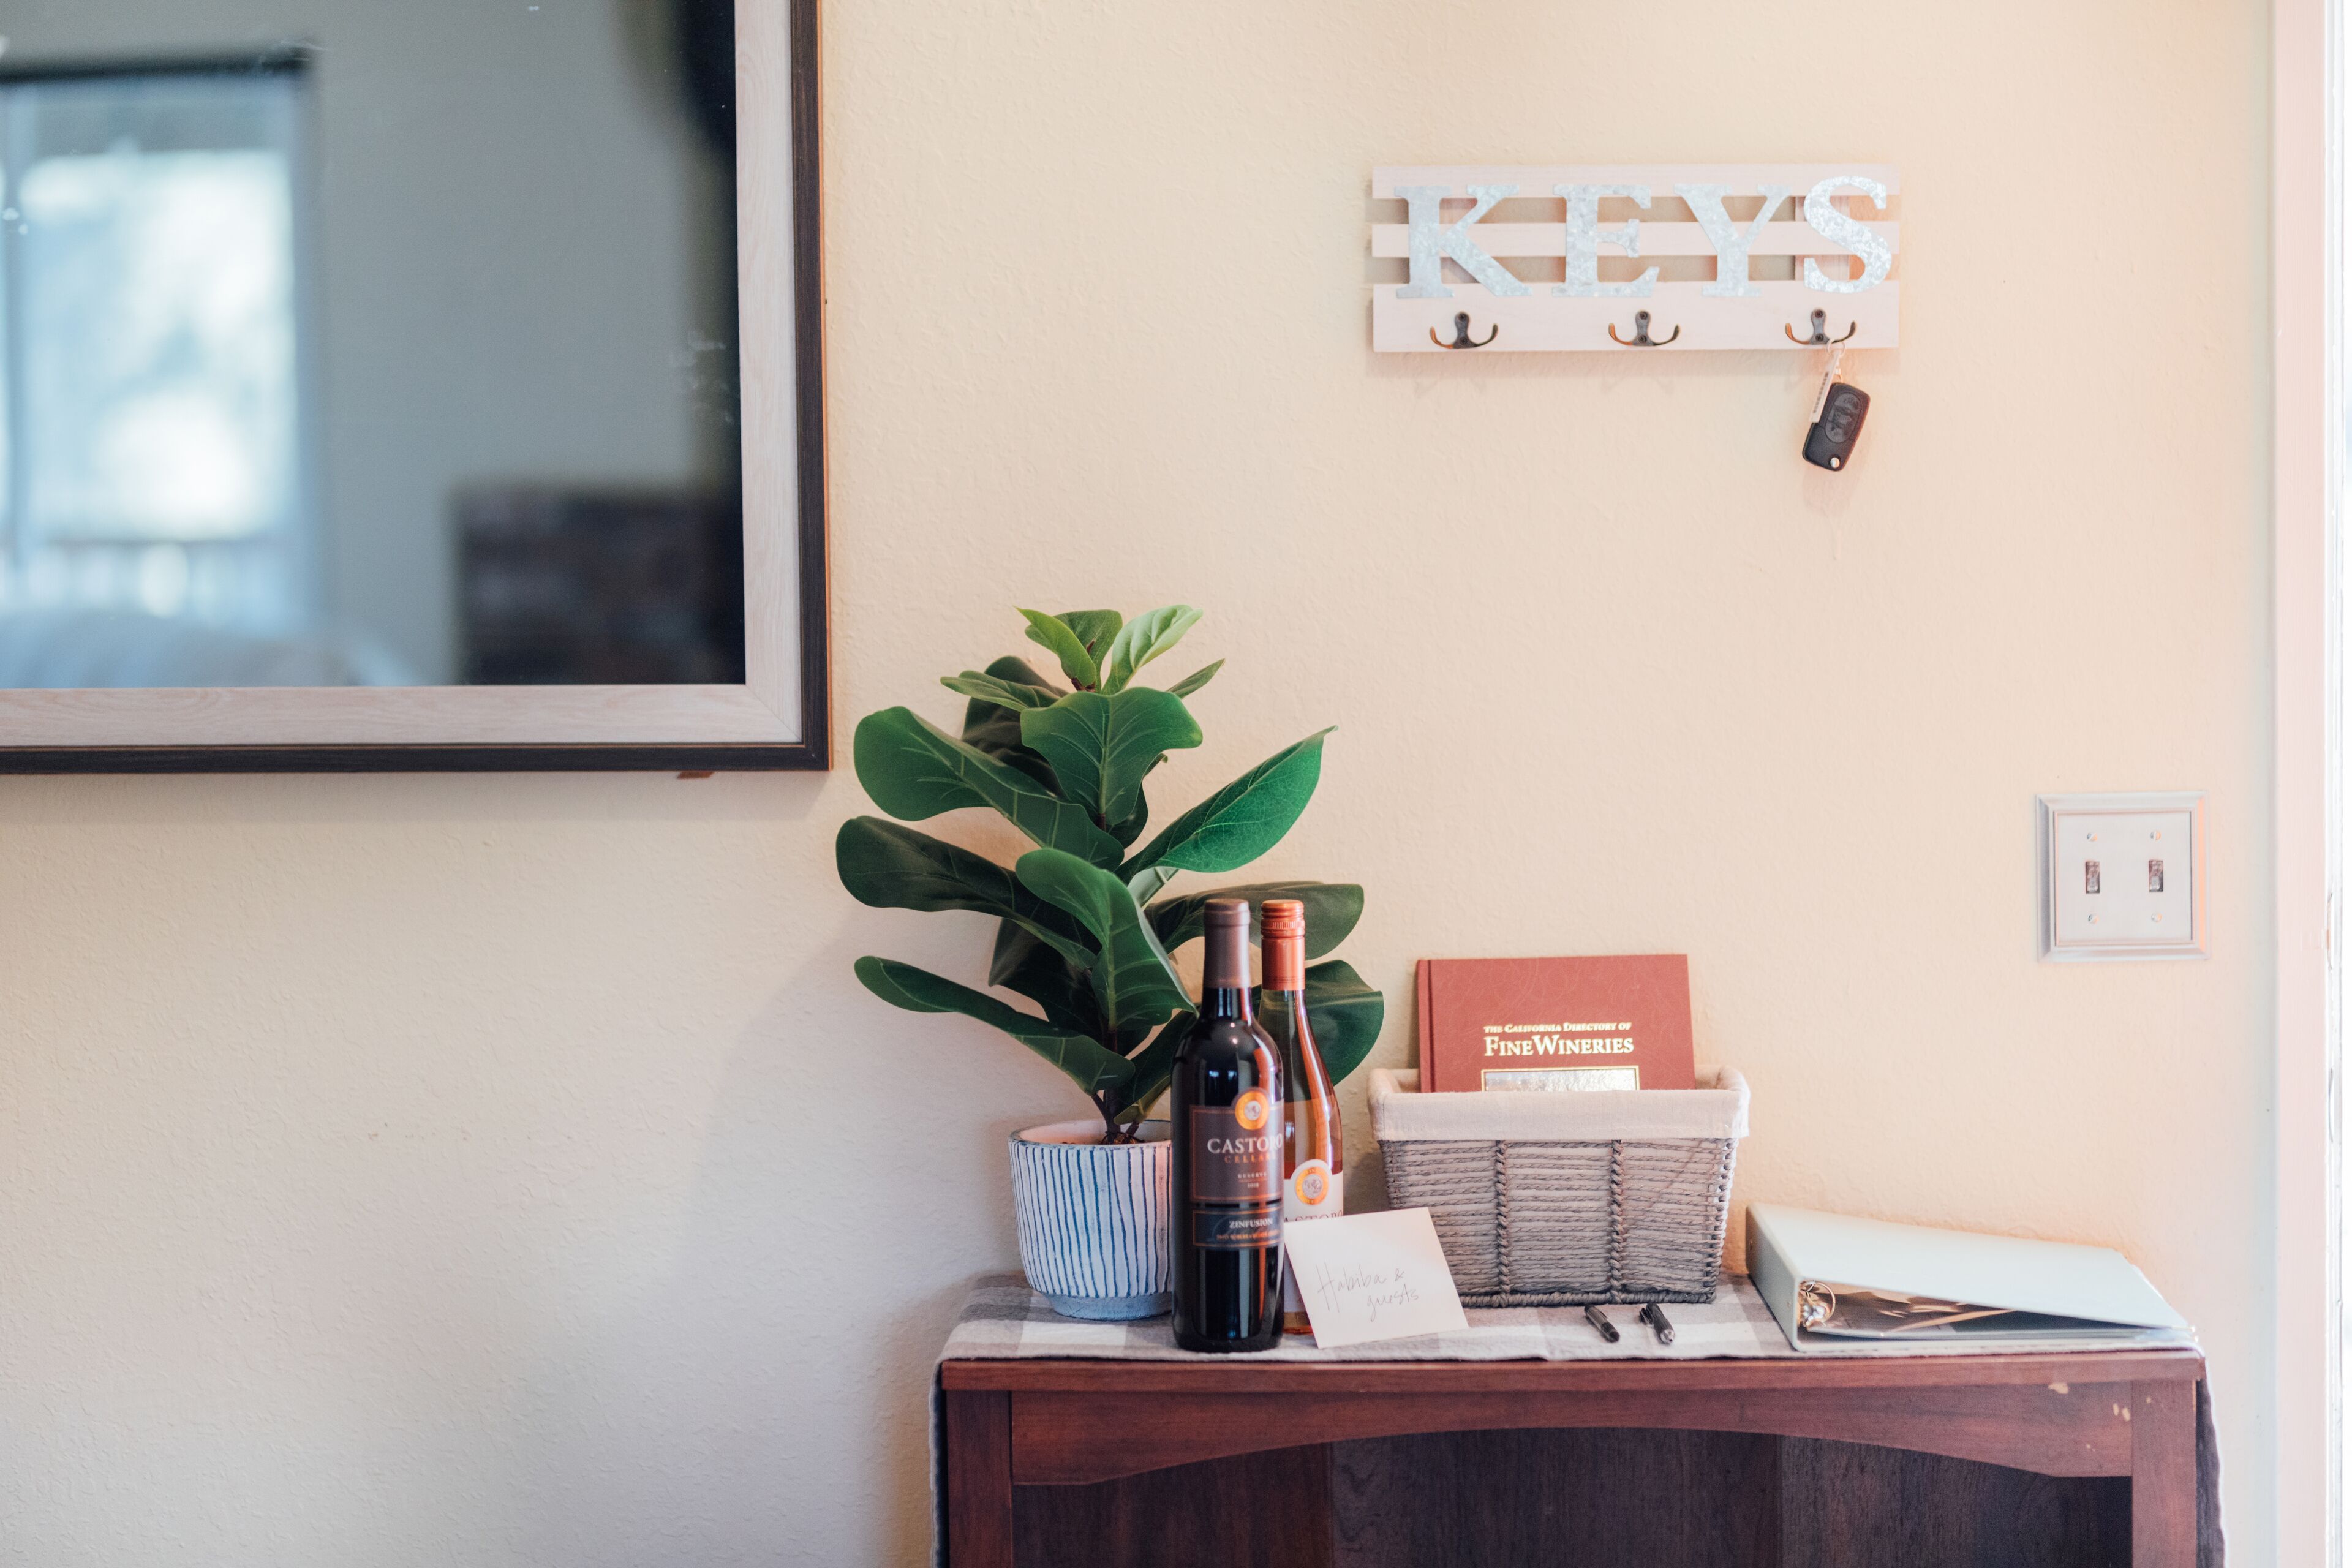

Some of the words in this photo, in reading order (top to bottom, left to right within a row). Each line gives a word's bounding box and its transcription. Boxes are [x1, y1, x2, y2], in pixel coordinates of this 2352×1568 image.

[1394, 176, 1893, 298] KEYS
[1504, 1023, 1562, 1033] CALIFORNIA
[1563, 1022, 1618, 1031] DIRECTORY
[1207, 1133, 1283, 1154] CASTORO
[1225, 1153, 1275, 1163] CELLA
[1366, 1283, 1419, 1322] guests
